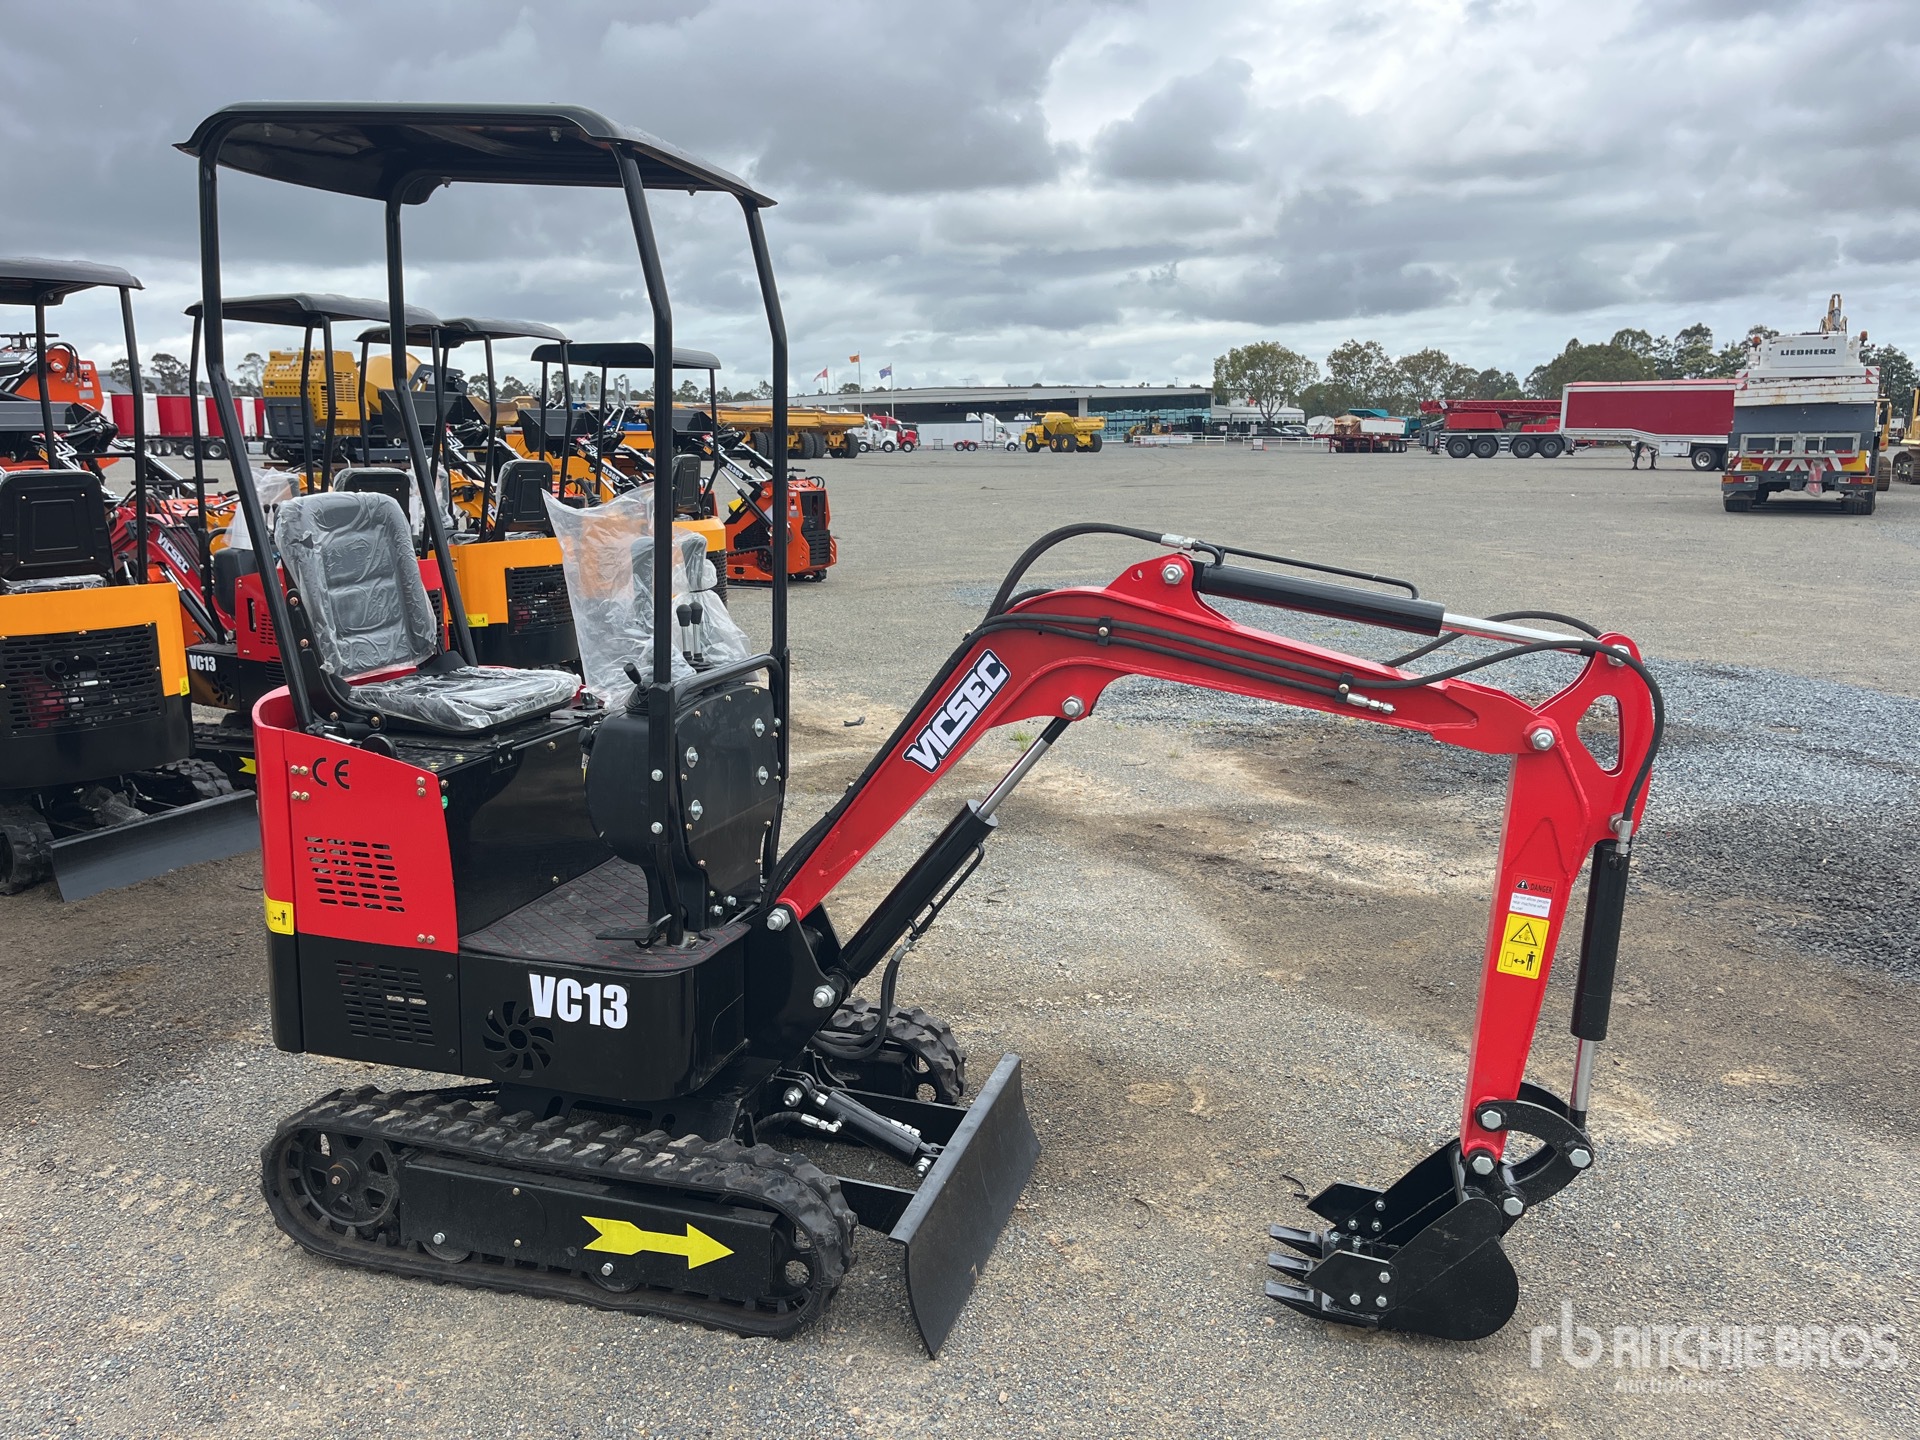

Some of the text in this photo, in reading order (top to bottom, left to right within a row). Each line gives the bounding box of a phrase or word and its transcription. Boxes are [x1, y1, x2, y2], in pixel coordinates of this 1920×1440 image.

[156, 532, 190, 574] VICSEC
[188, 654, 217, 672] VC13
[906, 652, 1009, 771] VICSEC
[312, 757, 350, 790] CE
[1530, 883, 1552, 893] DANGER
[529, 974, 628, 1029] VC13
